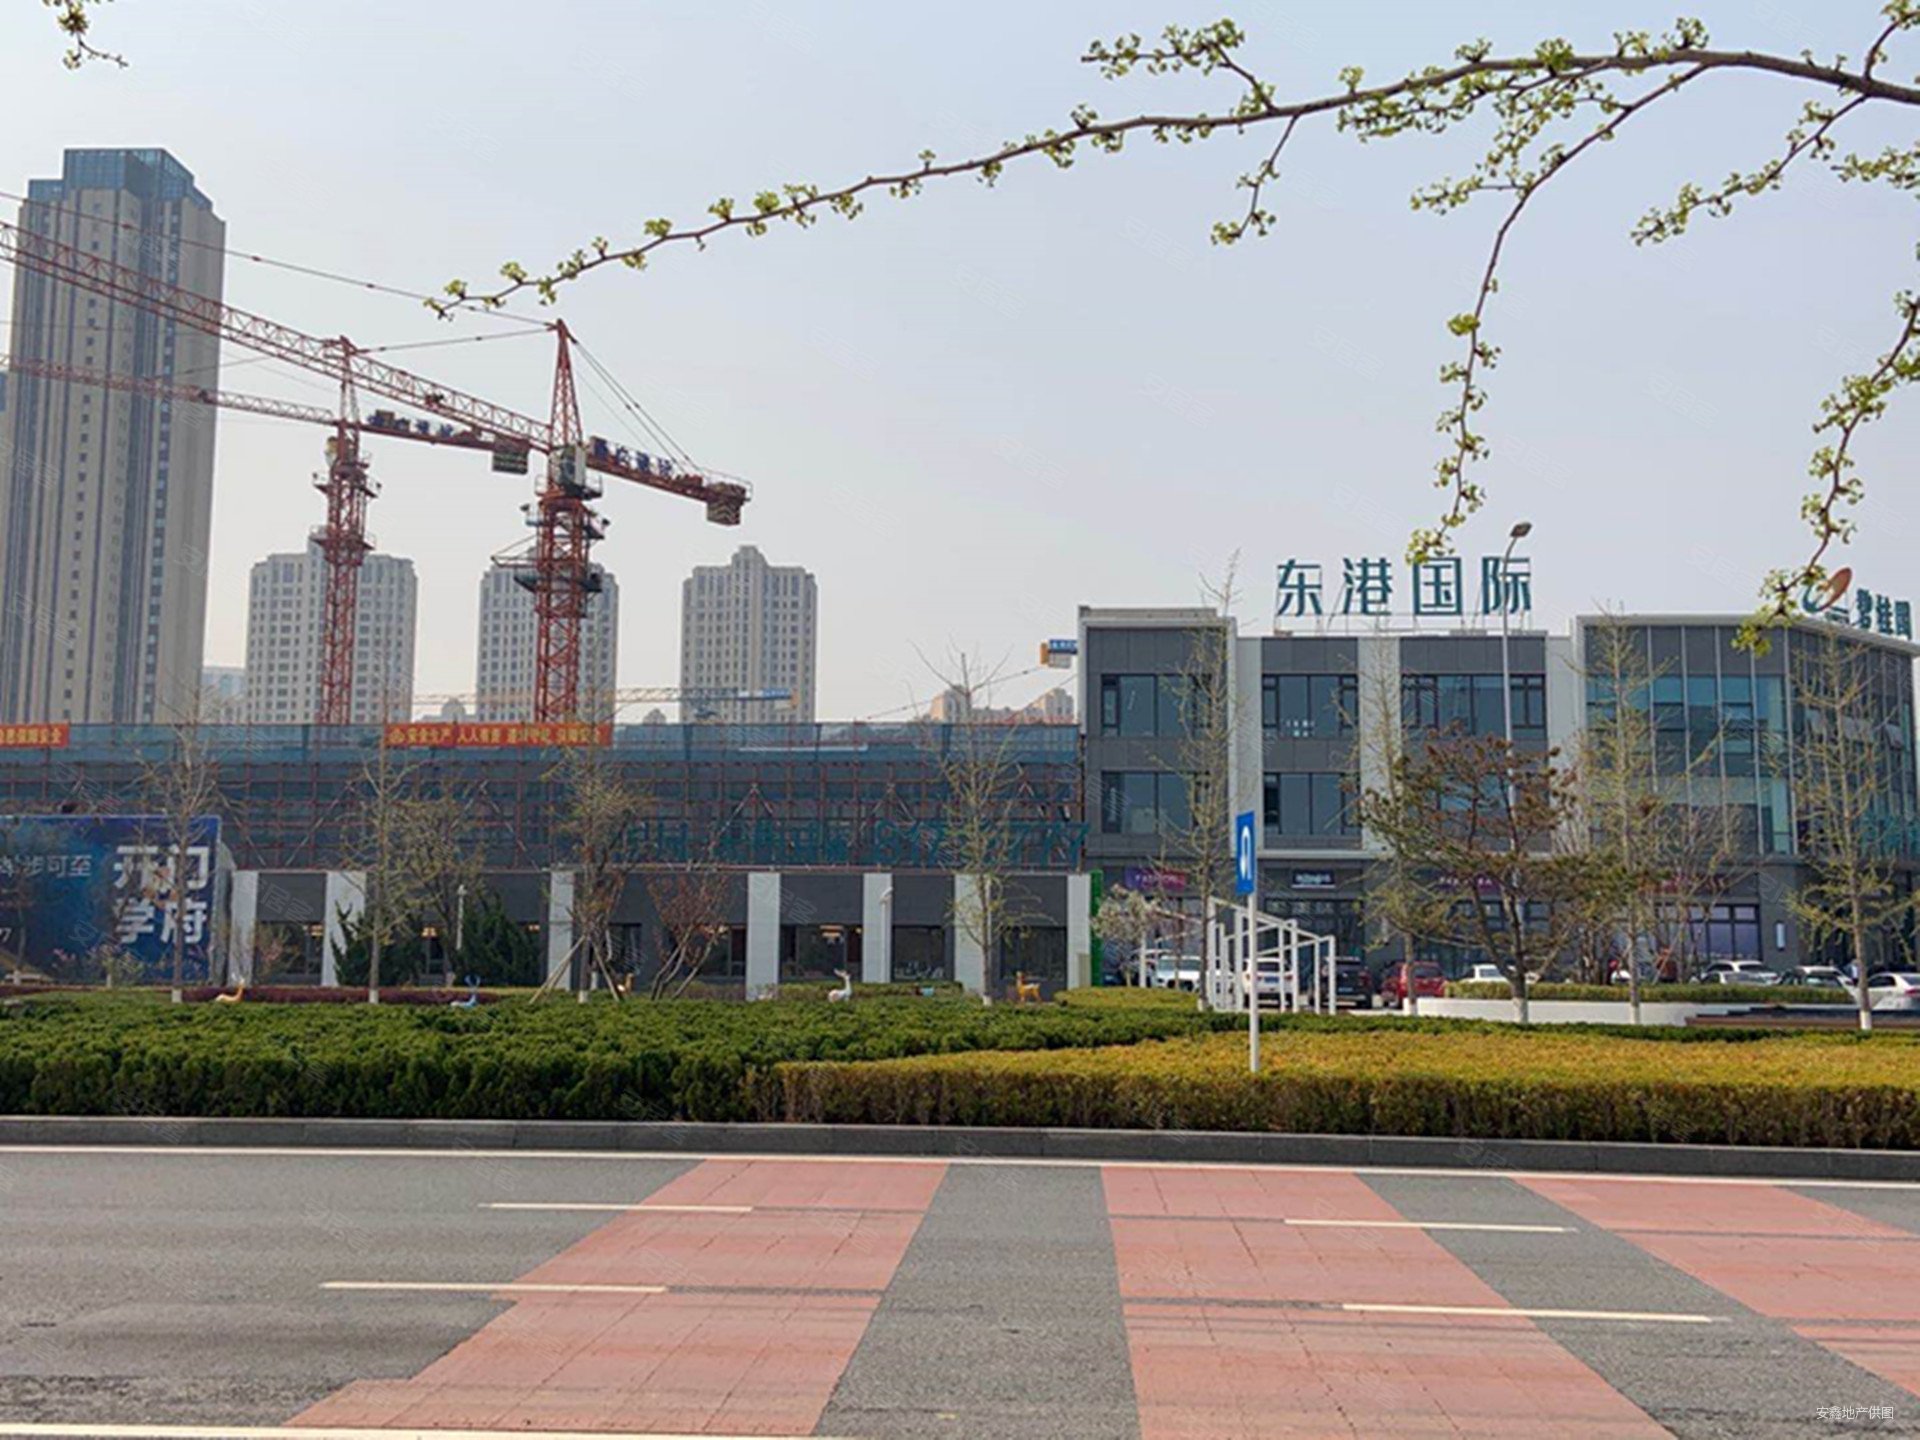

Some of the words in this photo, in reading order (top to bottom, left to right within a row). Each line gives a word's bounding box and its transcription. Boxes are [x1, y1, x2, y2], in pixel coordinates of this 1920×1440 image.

[1277, 557, 1532, 616] 东港国际
[113, 845, 210, 890] 开门
[114, 897, 208, 944] 学府
